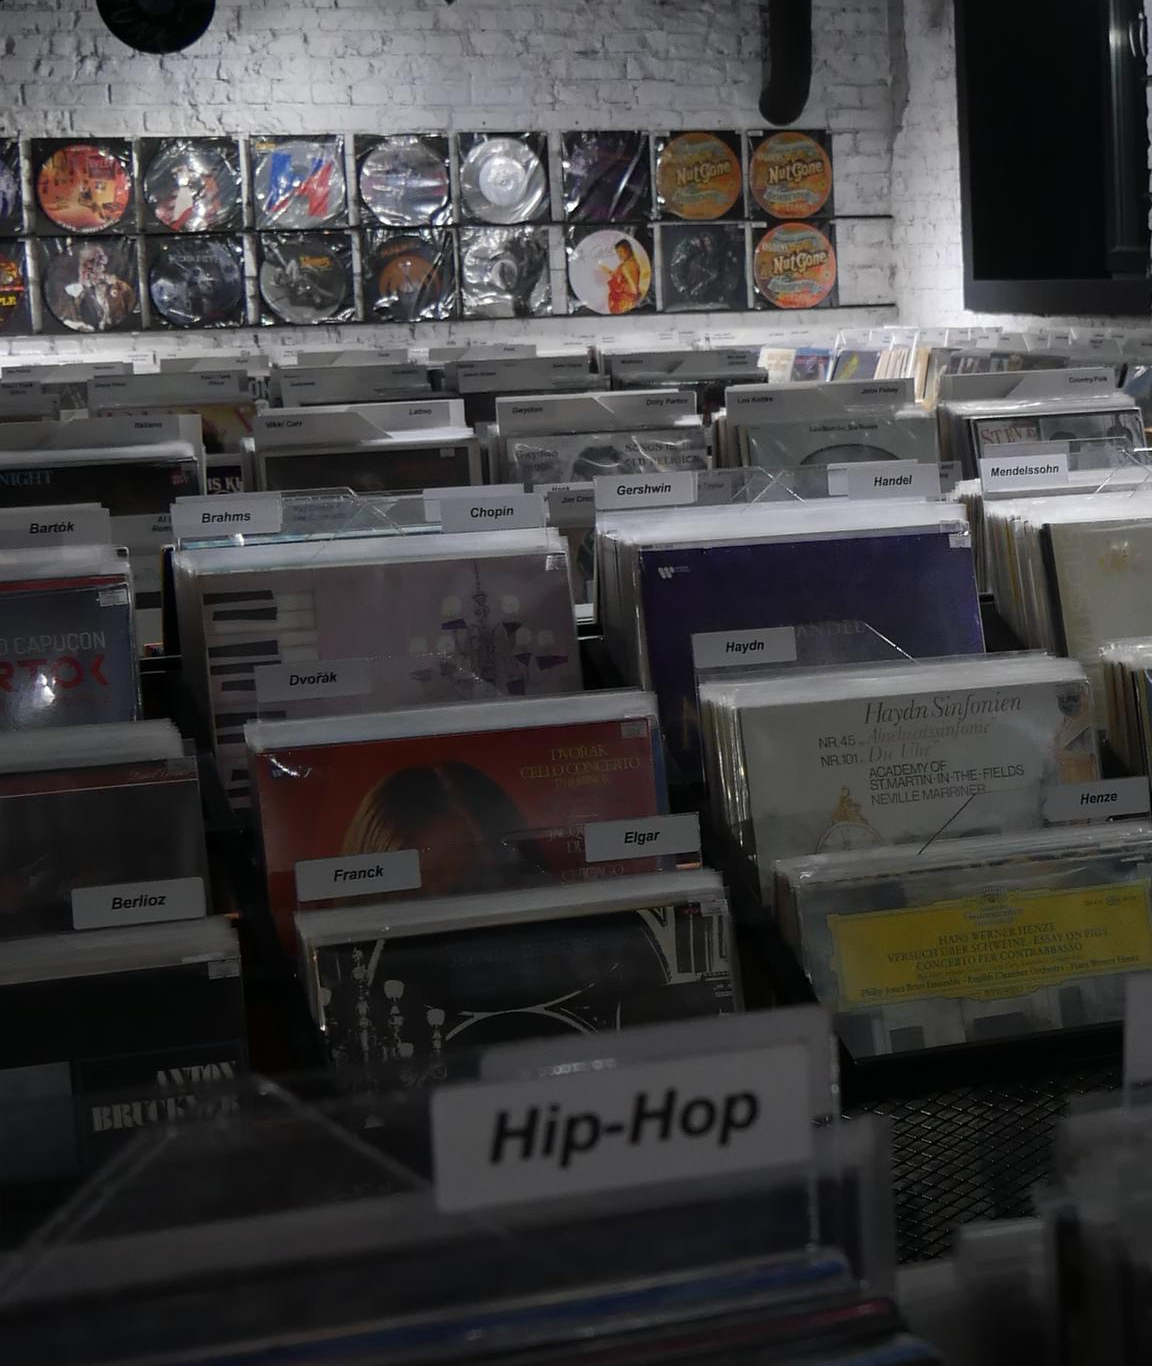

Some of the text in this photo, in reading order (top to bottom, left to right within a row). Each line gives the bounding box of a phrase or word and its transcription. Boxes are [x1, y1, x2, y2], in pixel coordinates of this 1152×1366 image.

[990, 464, 1060, 477] Mendelssohn
[873, 475, 913, 487] Handel
[616, 482, 672, 496] Gershwin
[201, 511, 251, 524] Brahms
[470, 505, 515, 519] Chopin
[29, 521, 75, 534] Bartók
[726, 639, 765, 654] Haydn
[289, 670, 338, 688] Dvořák
[864, 693, 1022, 726] Haydn Sinfonien
[868, 760, 948, 779] ACADEMY OF
[871, 784, 986, 806] NEVILLE MARRINER
[1080, 790, 1118, 805] Henze
[624, 829, 660, 846] Elgar
[333, 865, 384, 882] Franck
[112, 892, 166, 910] Berlioz
[1018, 922, 1057, 937] HENZE
[916, 956, 977, 972] CONCERTO
[490, 1088, 760, 1168] Hip-Hop
